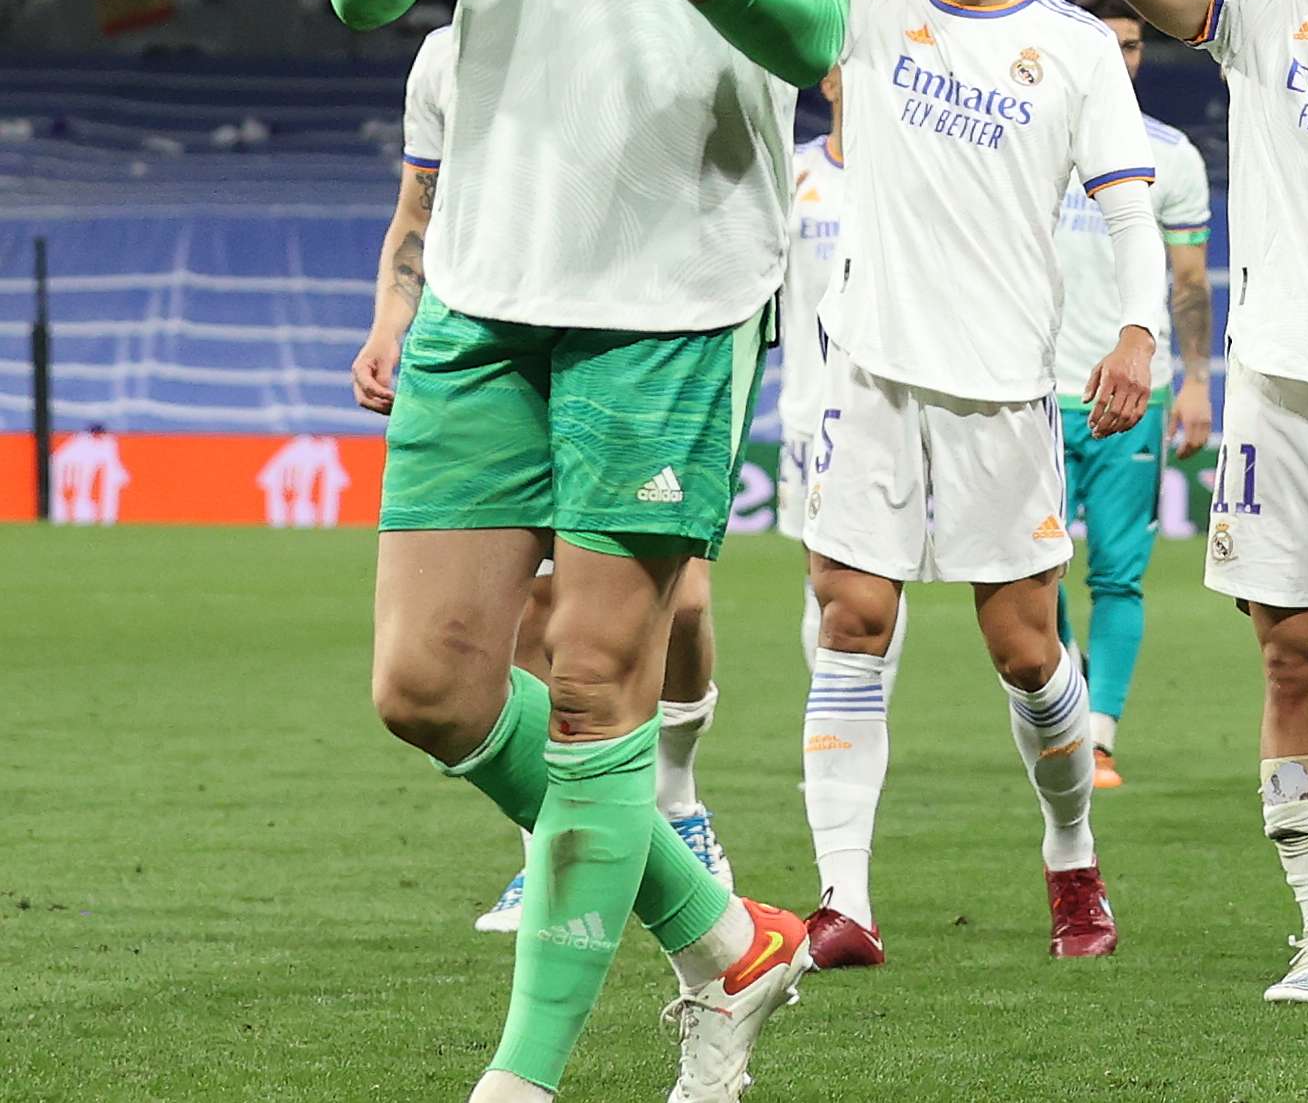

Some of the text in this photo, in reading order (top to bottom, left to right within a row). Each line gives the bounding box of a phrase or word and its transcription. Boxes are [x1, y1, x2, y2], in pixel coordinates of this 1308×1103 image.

[892, 55, 1033, 125] Emirates
[900, 99, 1005, 149] FLY BETTER
[815, 409, 842, 474] 5
[636, 488, 684, 503] adidas
[1213, 443, 1262, 515] 11
